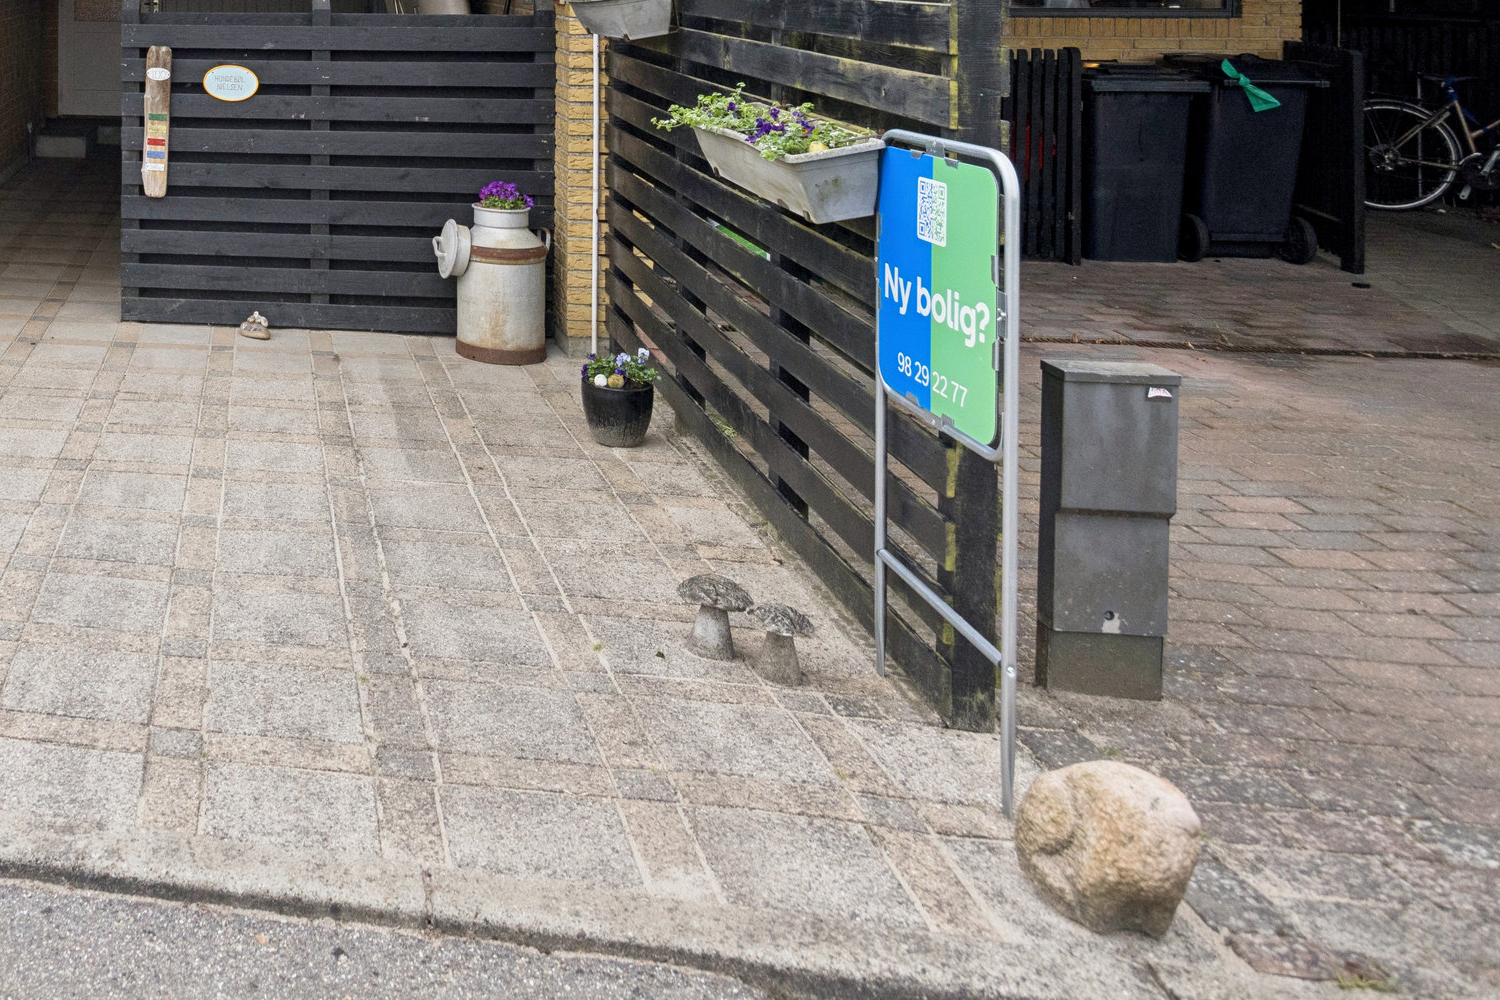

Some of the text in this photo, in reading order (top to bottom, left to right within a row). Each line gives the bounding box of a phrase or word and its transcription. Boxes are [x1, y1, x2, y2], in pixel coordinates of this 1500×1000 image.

[217, 83, 243, 91] NIELSEN
[884, 263, 990, 348] Ny bolig?
[897, 351, 968, 408] 98 29 22 77
